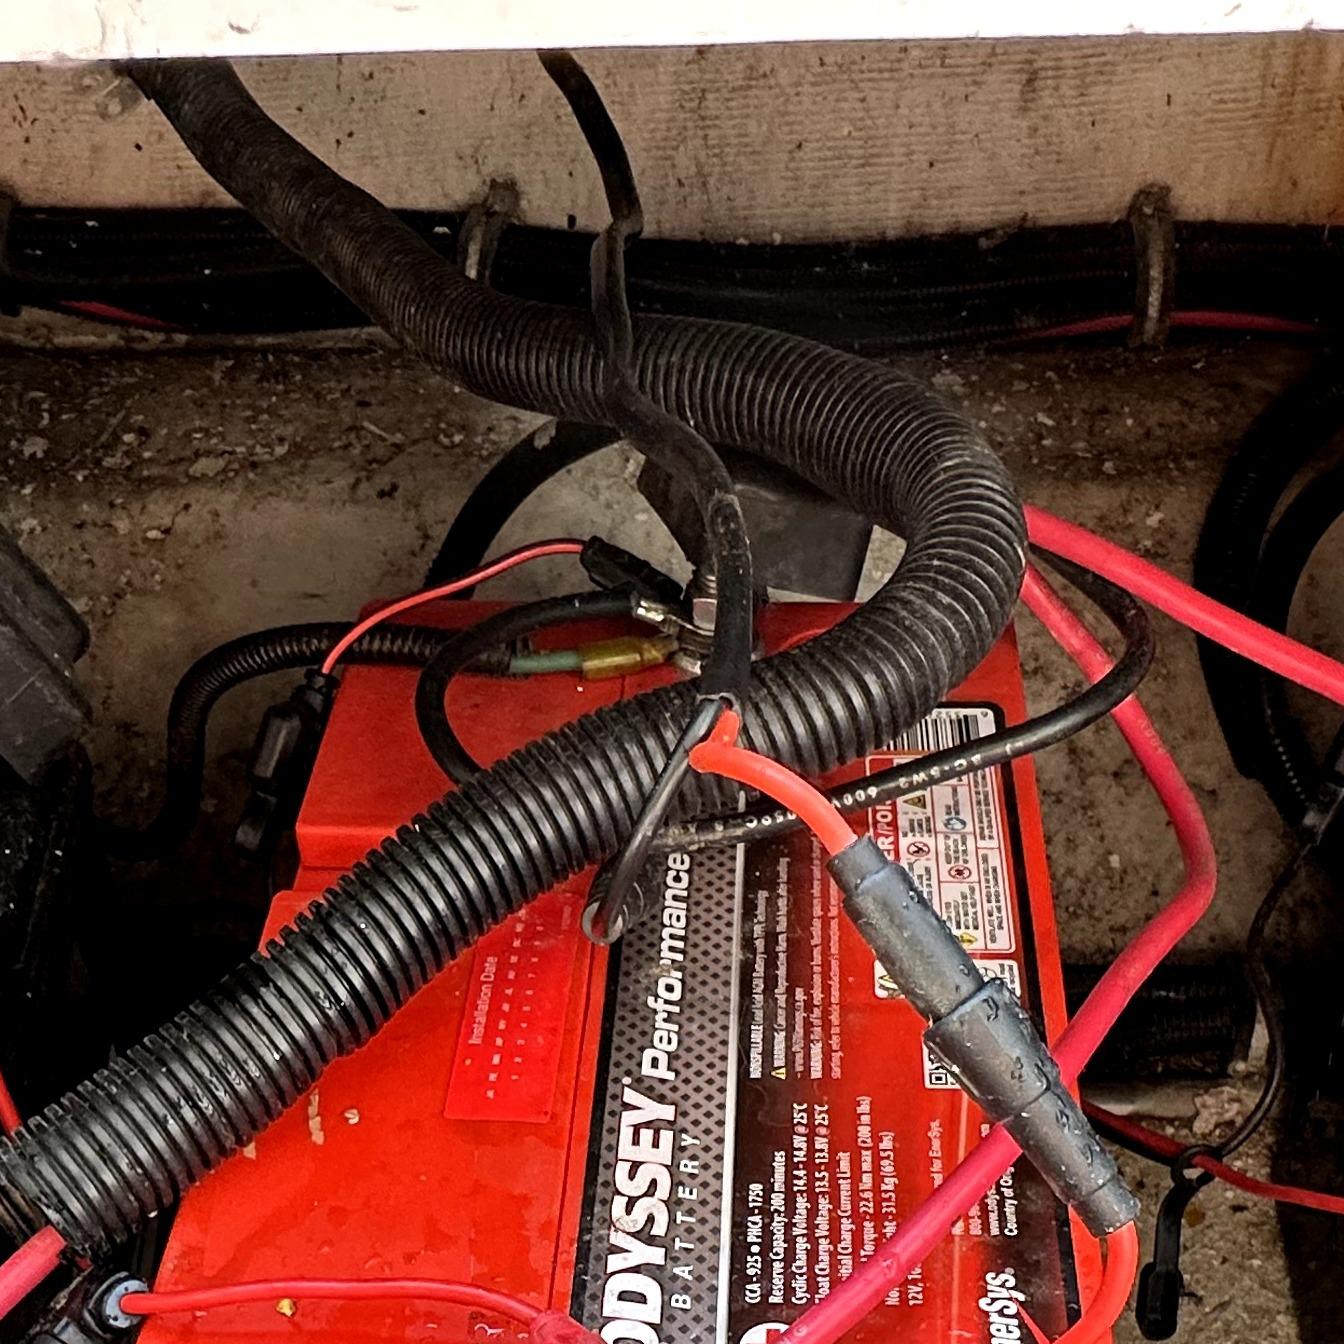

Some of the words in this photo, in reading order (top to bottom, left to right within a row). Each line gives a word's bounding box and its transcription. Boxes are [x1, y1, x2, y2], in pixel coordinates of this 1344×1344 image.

[478, 955, 497, 981] Date
[640, 851, 690, 1080] Performance
[467, 983, 493, 1044] Installation
[855, 1095, 872, 1114] lbs)
[856, 1113, 871, 1125] in
[792, 1134, 808, 1162] 14.8V
[814, 1135, 829, 1164] 13.8V
[856, 1125, 874, 1147] (200
[878, 1130, 895, 1150] lbs)
[770, 1150, 785, 1191] minutes
[835, 1150, 850, 1177] Limit
[859, 1148, 872, 1171] max
[879, 1149, 896, 1176] (69.5
[792, 1169, 807, 1191] 14.4
[814, 1170, 829, 1192] 13.5
[880, 1176, 899, 1191] Kg
[748, 1182, 763, 1208] 1750
[770, 1191, 785, 1212] 200
[836, 1177, 851, 1216] Current
[858, 1190, 874, 1213] 22.6
[881, 1190, 897, 1214] 31.5
[669, 1131, 701, 1309] BATTERY
[791, 1192, 811, 1236] Voltage:
[814, 1193, 833, 1237] Voltage:
[747, 1214, 762, 1243] PHCA
[769, 1212, 788, 1260] Capacity:
[836, 1217, 856, 1254] Charge
[859, 1220, 878, 1255] Torque
[746, 1254, 762, 1276] 925
[791, 1235, 810, 1273] Charge
[814, 1236, 833, 1275] Charge
[745, 1282, 761, 1303] CCA
[768, 1260, 785, 1304] Reserve
[791, 1273, 810, 1304] Cyclic
